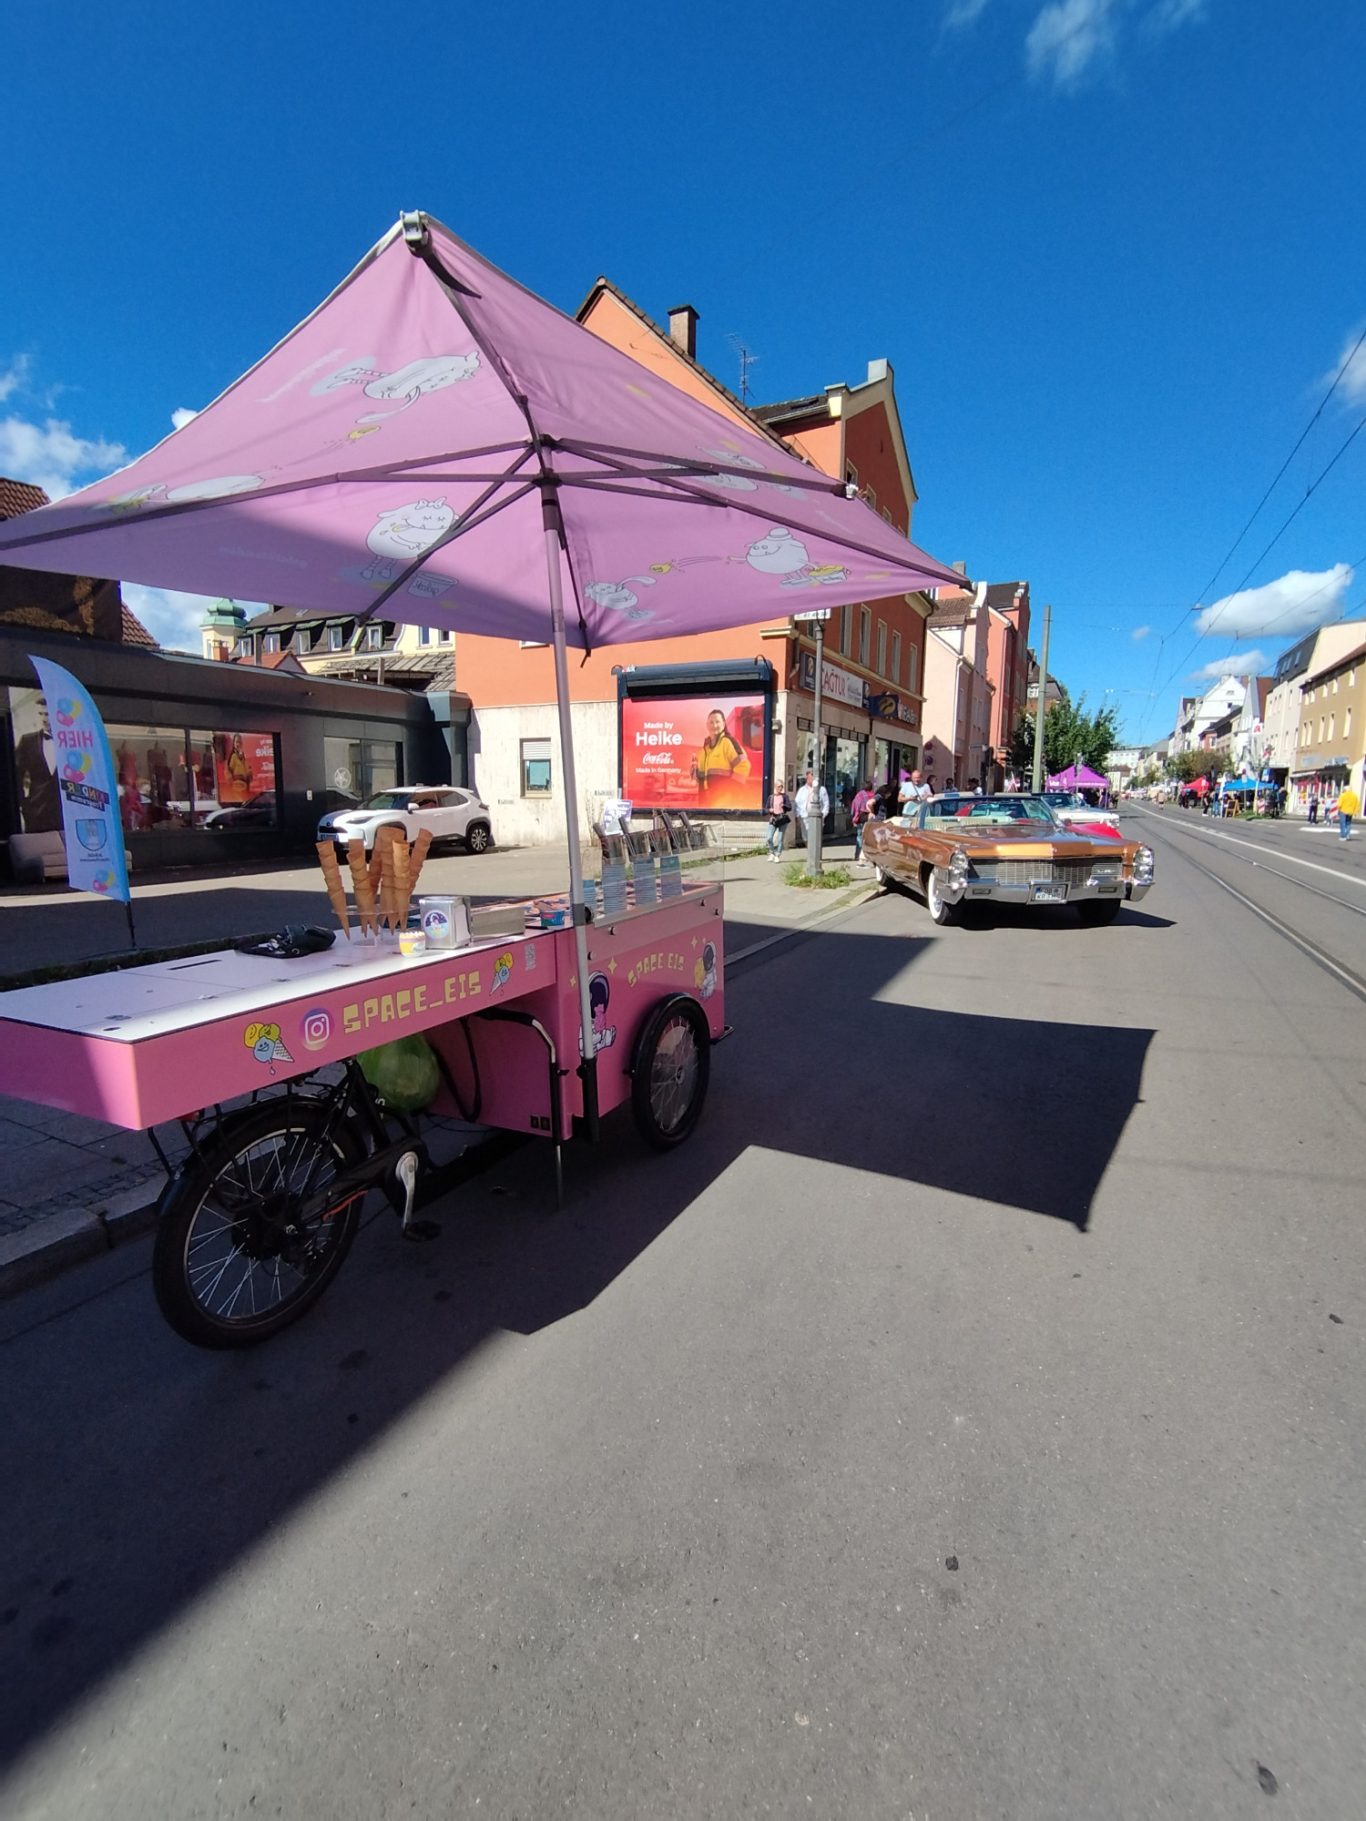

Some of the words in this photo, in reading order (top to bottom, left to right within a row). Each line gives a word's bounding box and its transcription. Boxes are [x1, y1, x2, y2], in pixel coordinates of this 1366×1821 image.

[643, 721, 663, 729] Made
[664, 721, 674, 730] by
[642, 751, 673, 765] Coca-Cola
[626, 952, 664, 988] SPACE
[667, 952, 685, 971] EIS
